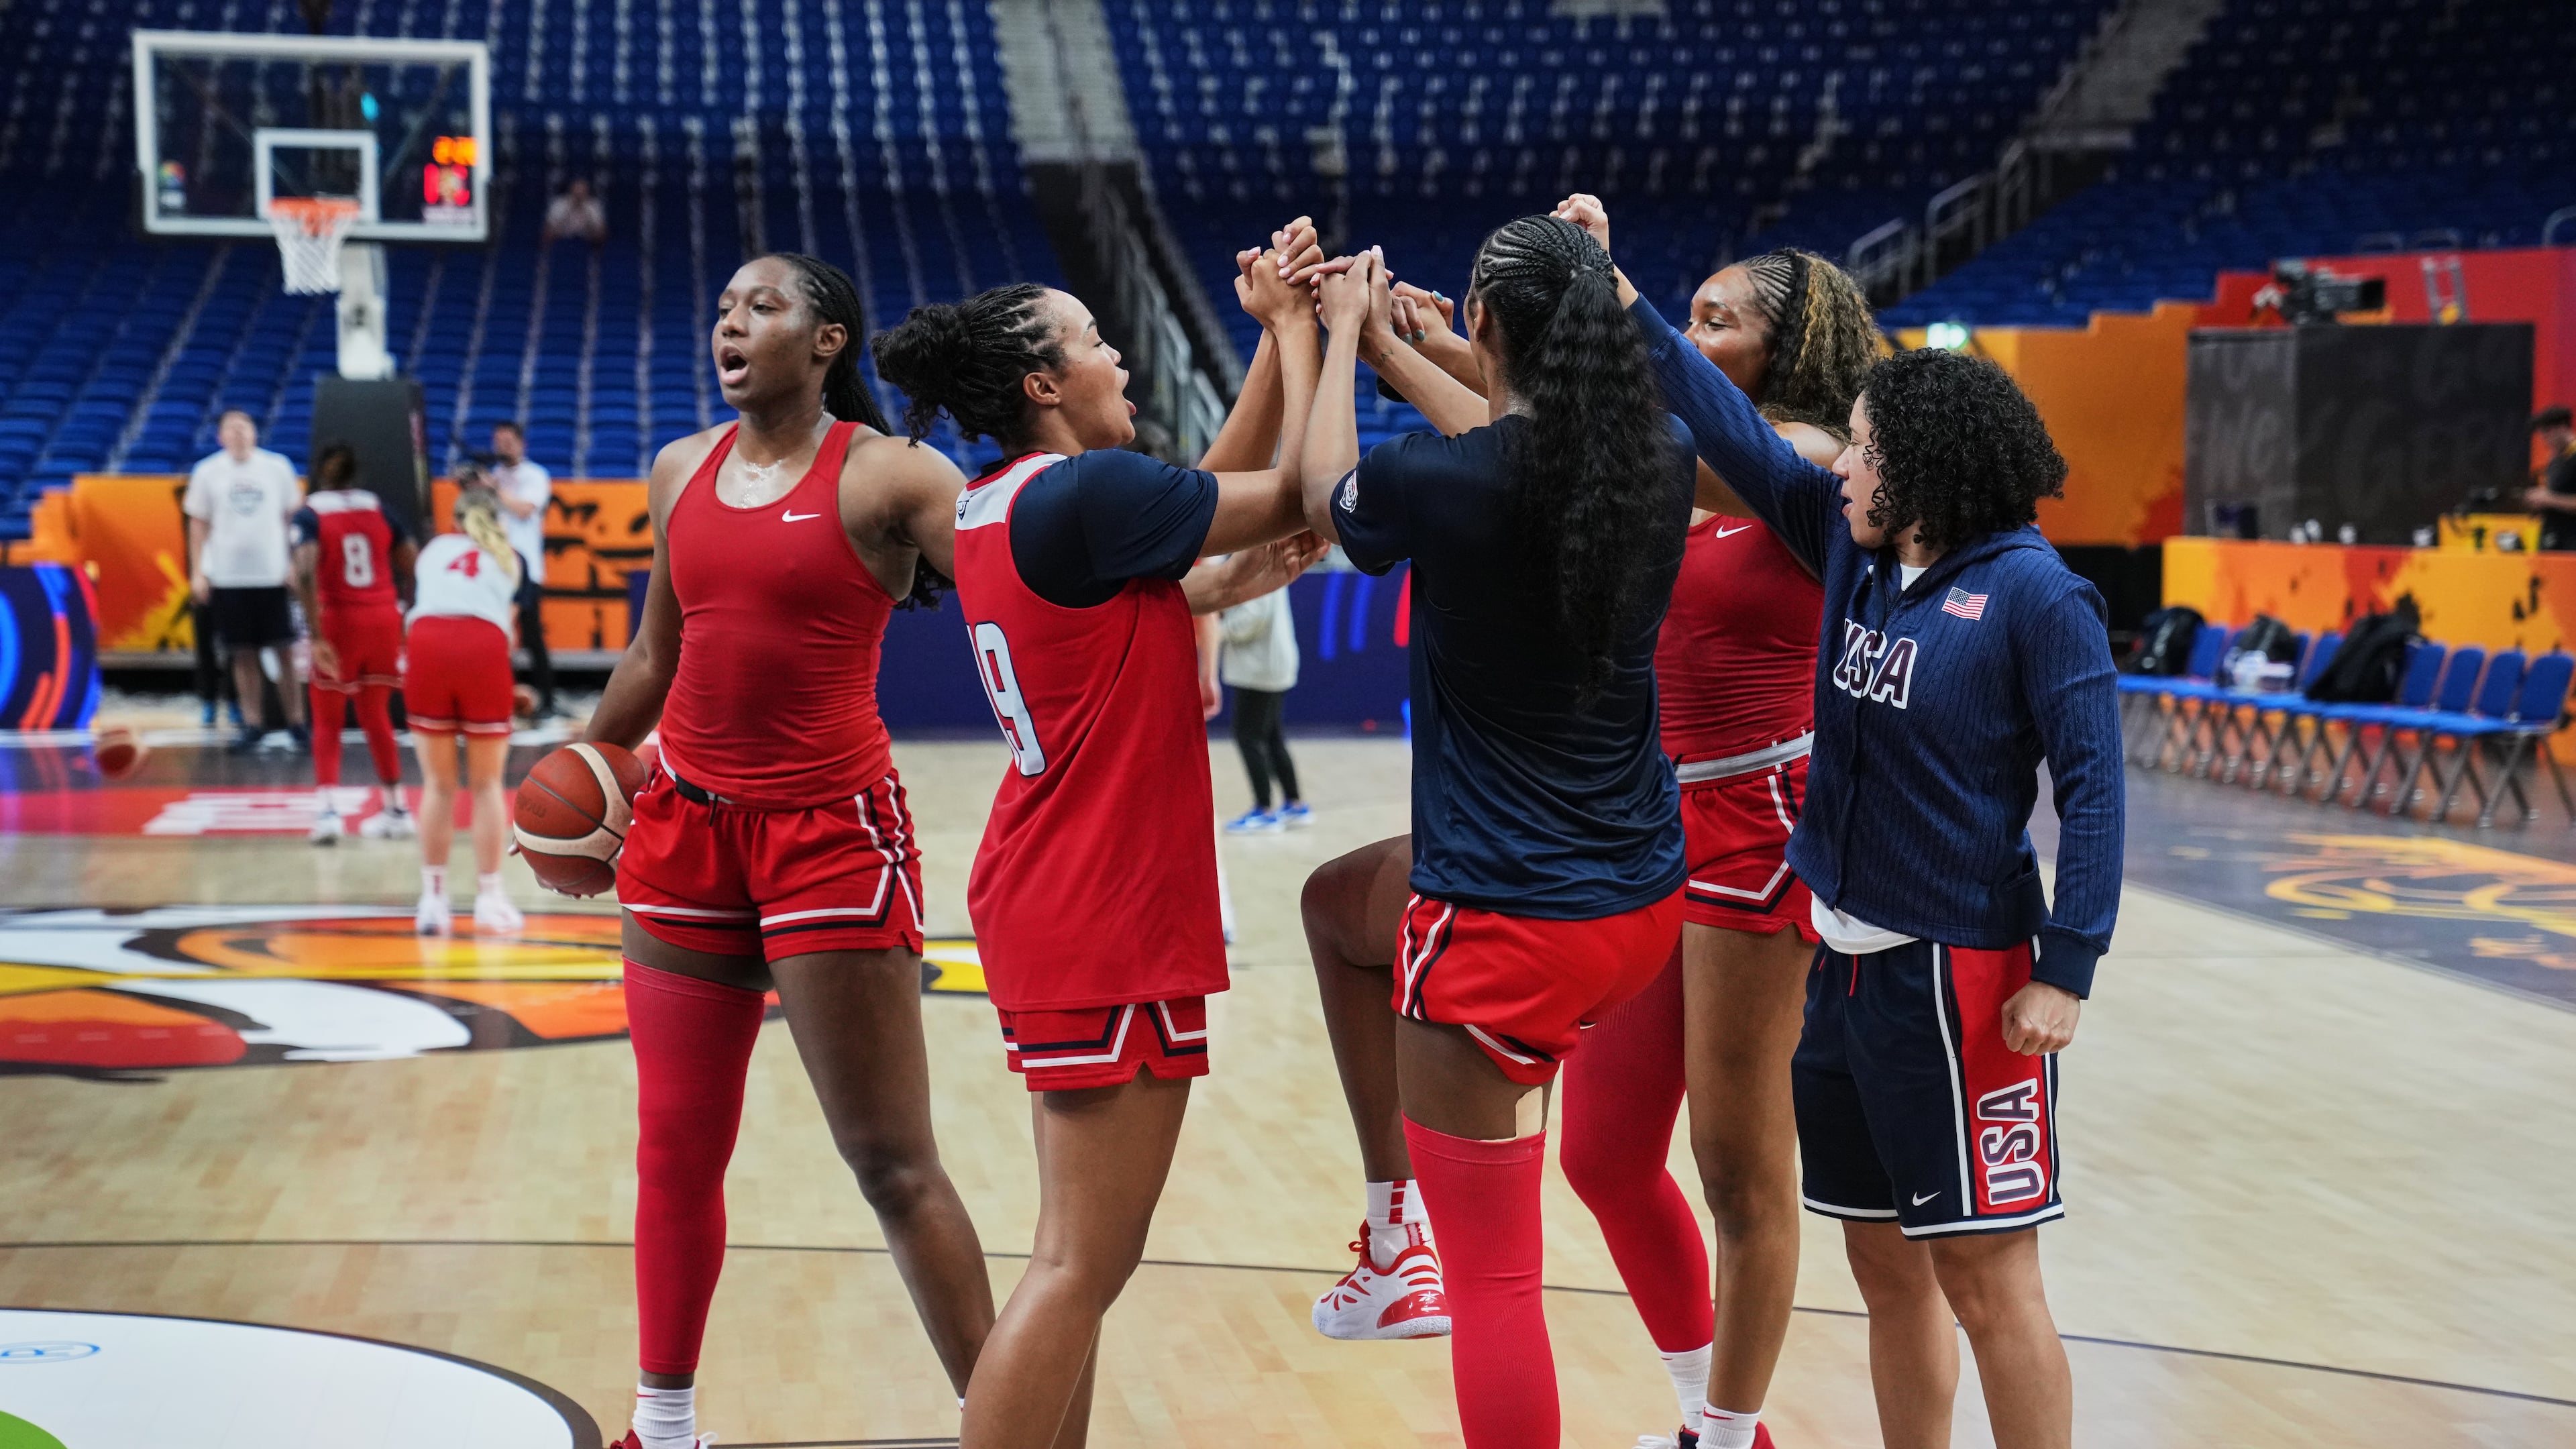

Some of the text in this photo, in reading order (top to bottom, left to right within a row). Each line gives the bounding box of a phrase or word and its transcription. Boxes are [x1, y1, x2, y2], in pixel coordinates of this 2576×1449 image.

[342, 533, 373, 588] 8
[447, 549, 480, 580] 4
[965, 620, 1047, 779] 9
[1833, 617, 1918, 710] USA
[1977, 1077, 2045, 1205] USA
